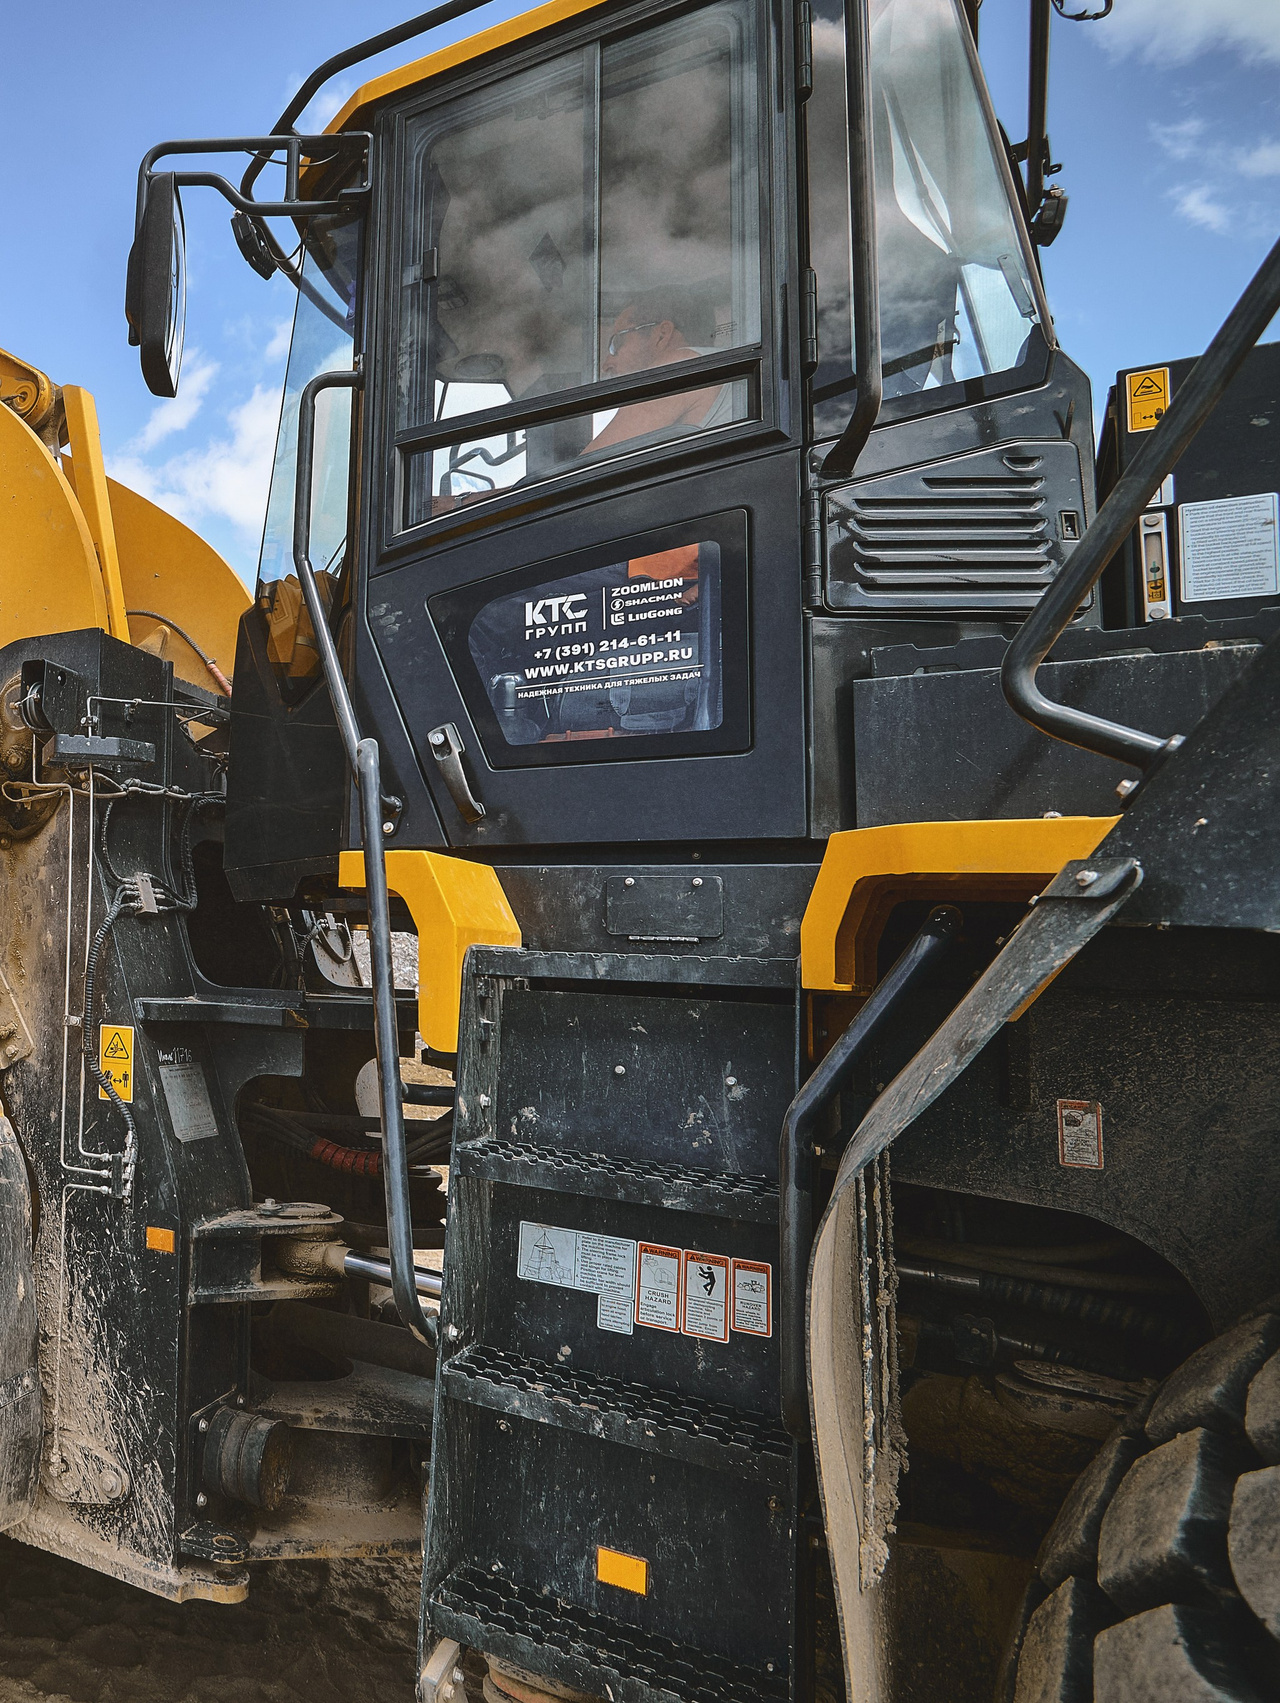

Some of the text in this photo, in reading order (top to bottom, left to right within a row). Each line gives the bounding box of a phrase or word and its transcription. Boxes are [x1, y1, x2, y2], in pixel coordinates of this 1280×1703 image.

[611, 577, 683, 597] ZOOMLION
[625, 592, 682, 607] SHACMAN
[525, 621, 587, 640] ГРУПП
[534, 630, 681, 661] +7 (391) 214-61-11
[525, 647, 692, 679] WWW.KTSGRUPP.RU
[518, 671, 701, 699] НАДЕЖНАЯ ТЕХНИКА ДЛЯ ТЯЖЕЛЫХ ЗАДАЧ
[645, 1296, 671, 1305] HAZARD
[648, 1290, 669, 1298] CRUSH
